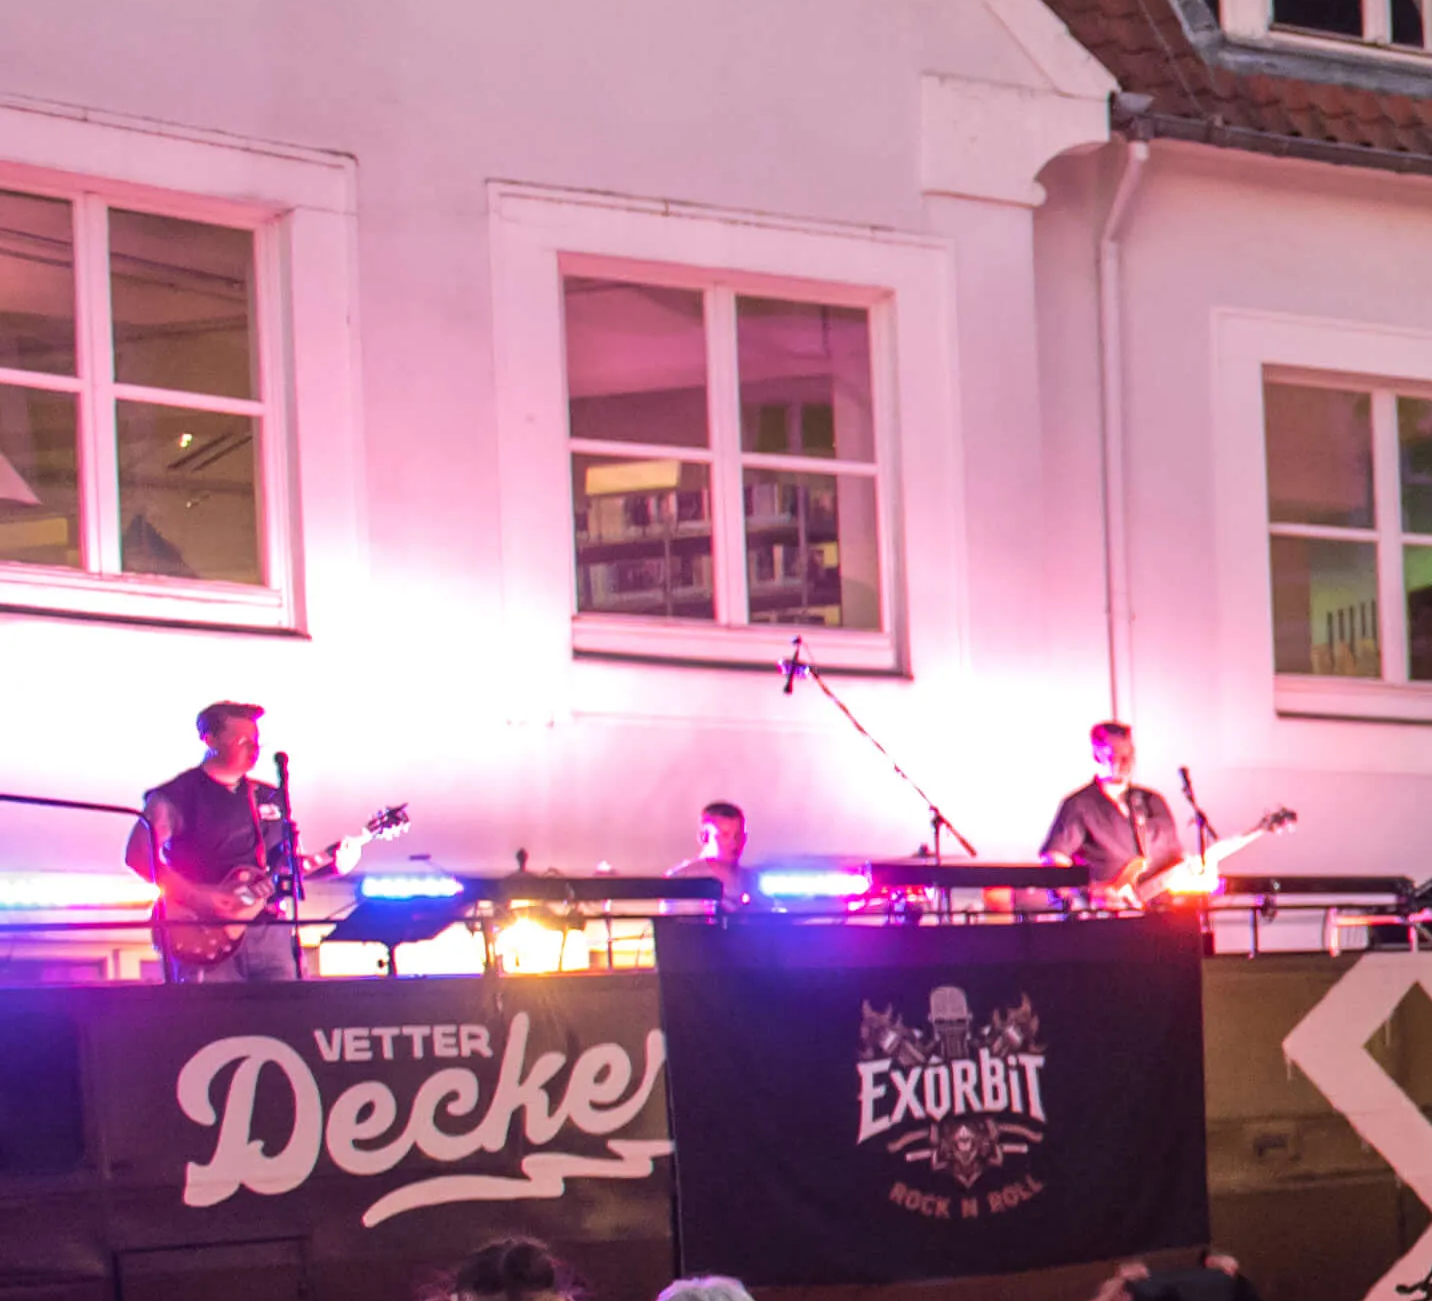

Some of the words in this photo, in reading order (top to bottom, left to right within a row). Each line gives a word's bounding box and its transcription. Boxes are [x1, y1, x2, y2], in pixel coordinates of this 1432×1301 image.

[314, 1023, 493, 1062] VETTER
[889, 1182, 951, 1219] ROCK
[961, 1197, 979, 1219] N
[987, 1172, 1045, 1213] ROLL
